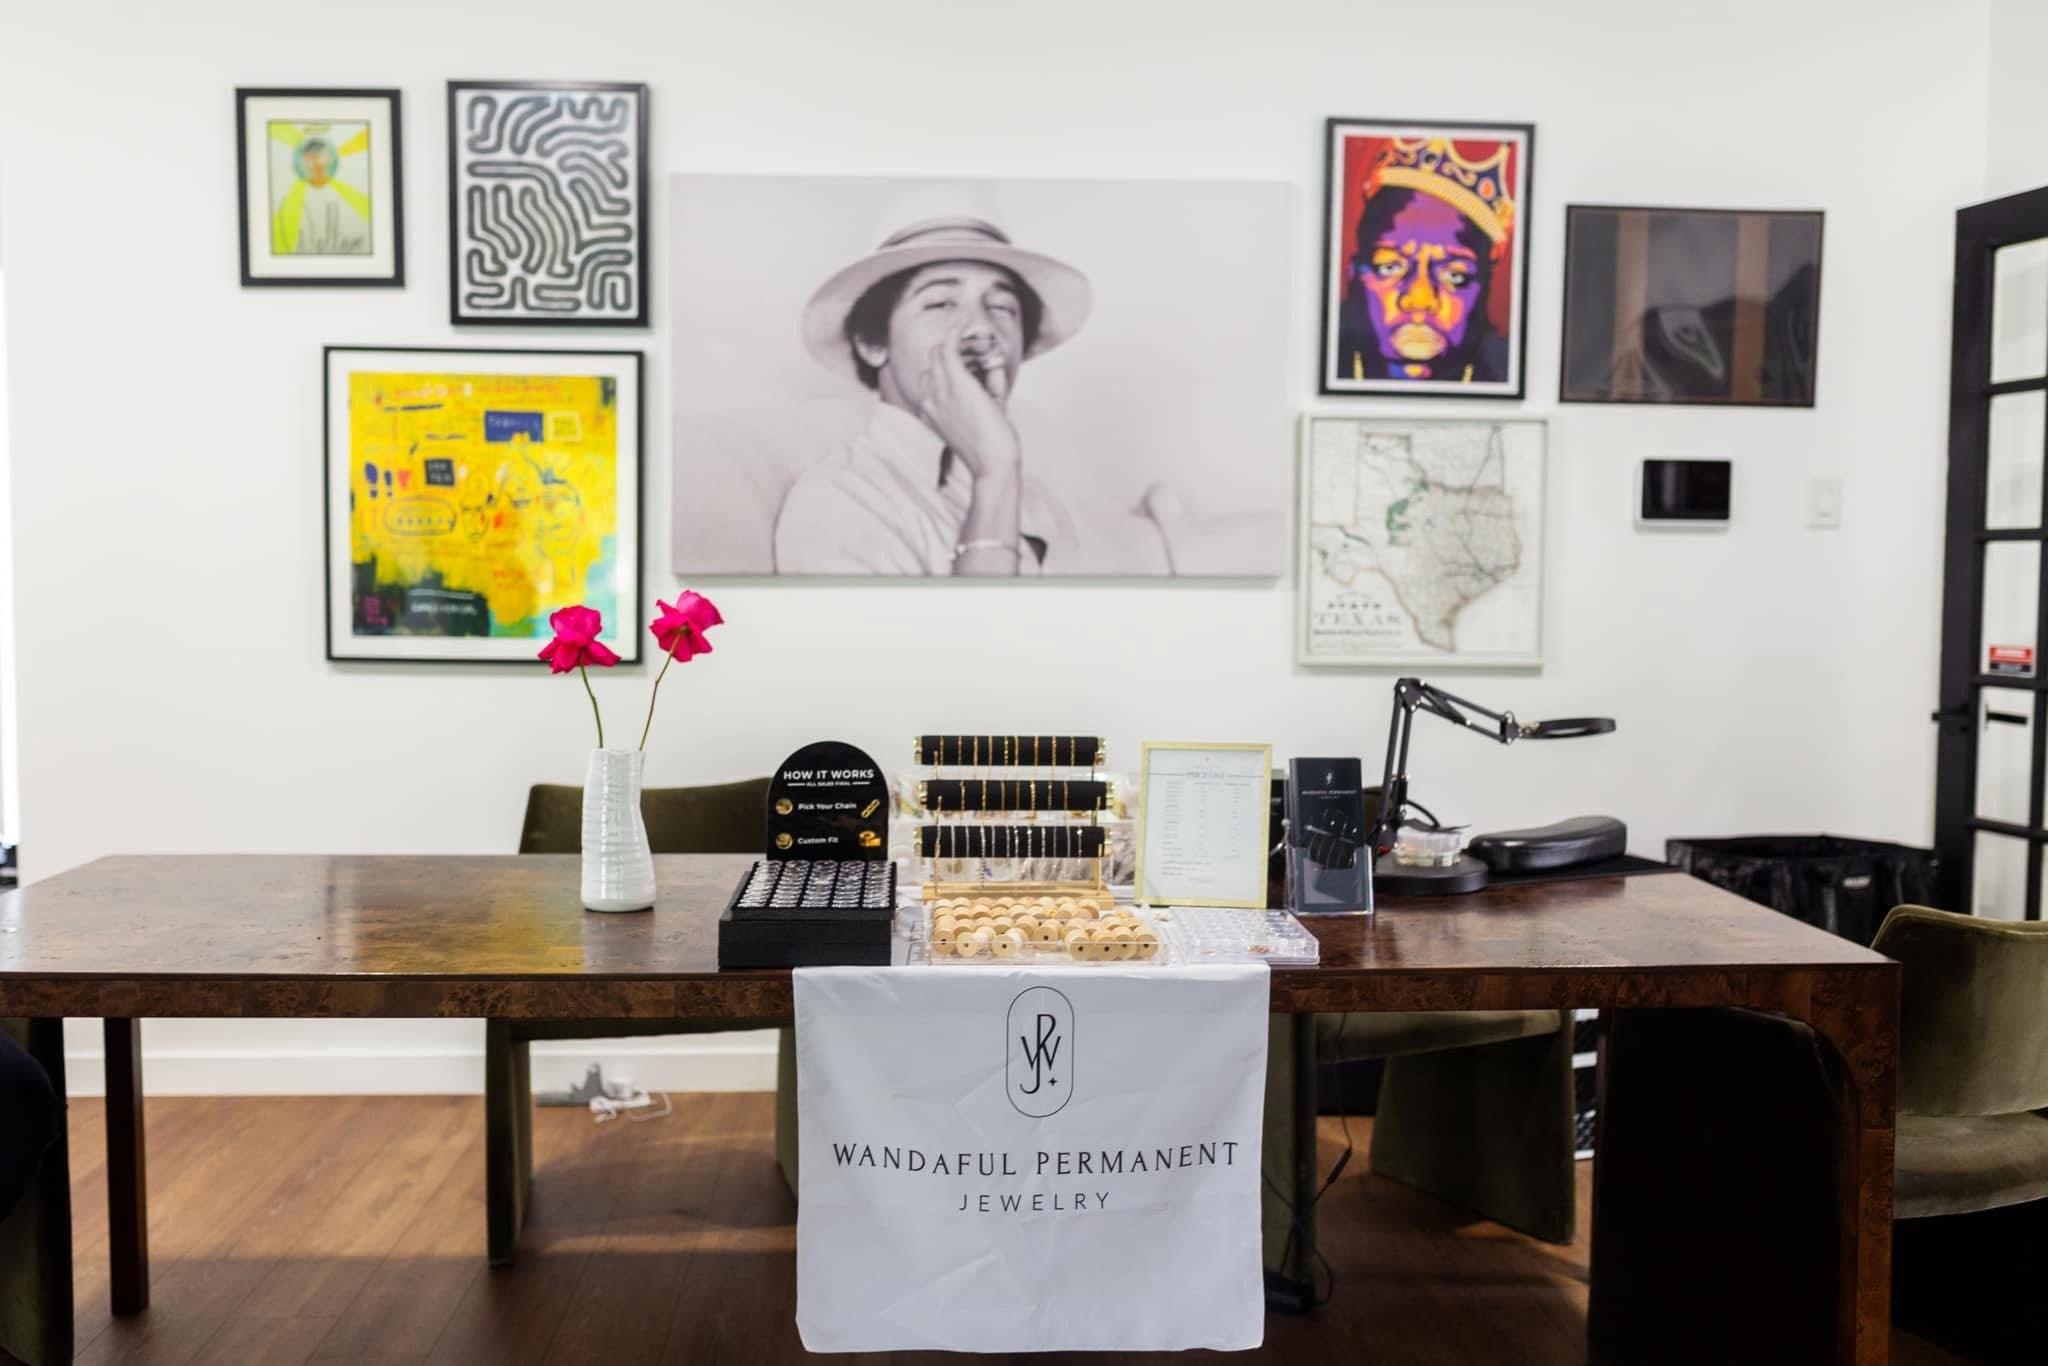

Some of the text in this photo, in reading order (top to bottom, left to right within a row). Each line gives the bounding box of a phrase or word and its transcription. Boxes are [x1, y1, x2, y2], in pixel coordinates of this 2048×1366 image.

[783, 769, 875, 780] HOW IT WORKS
[834, 802, 857, 810] Chain
[832, 1141, 1240, 1176] WANDAFUL PERMANENT
[958, 1191, 1110, 1213] JEWELRY
